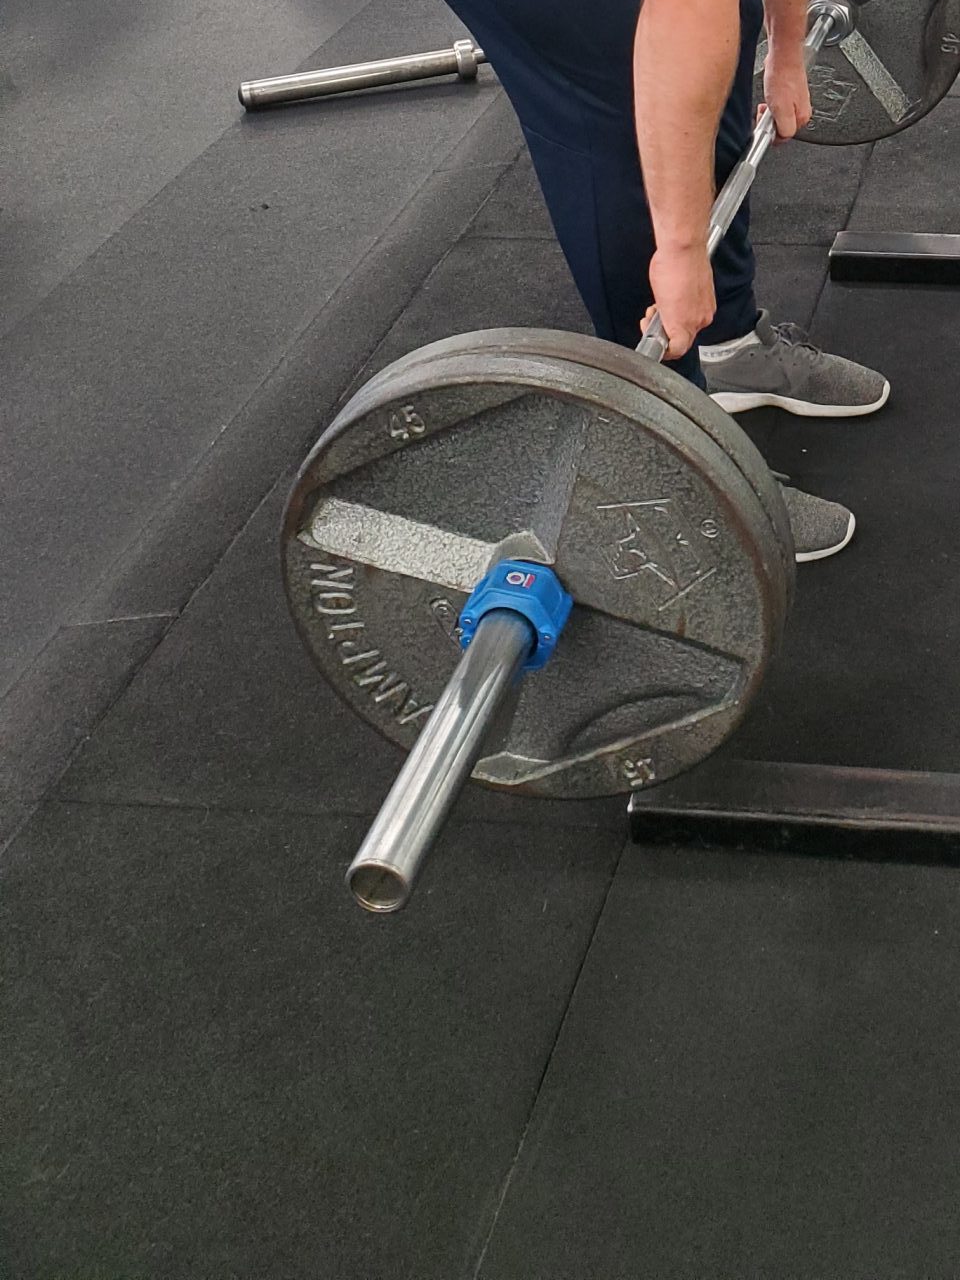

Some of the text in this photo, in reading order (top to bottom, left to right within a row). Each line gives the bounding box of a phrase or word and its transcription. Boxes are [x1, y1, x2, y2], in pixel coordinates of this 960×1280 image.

[940, 32, 960, 55] 45
[391, 405, 425, 439] 45
[310, 563, 434, 724] AMPTON
